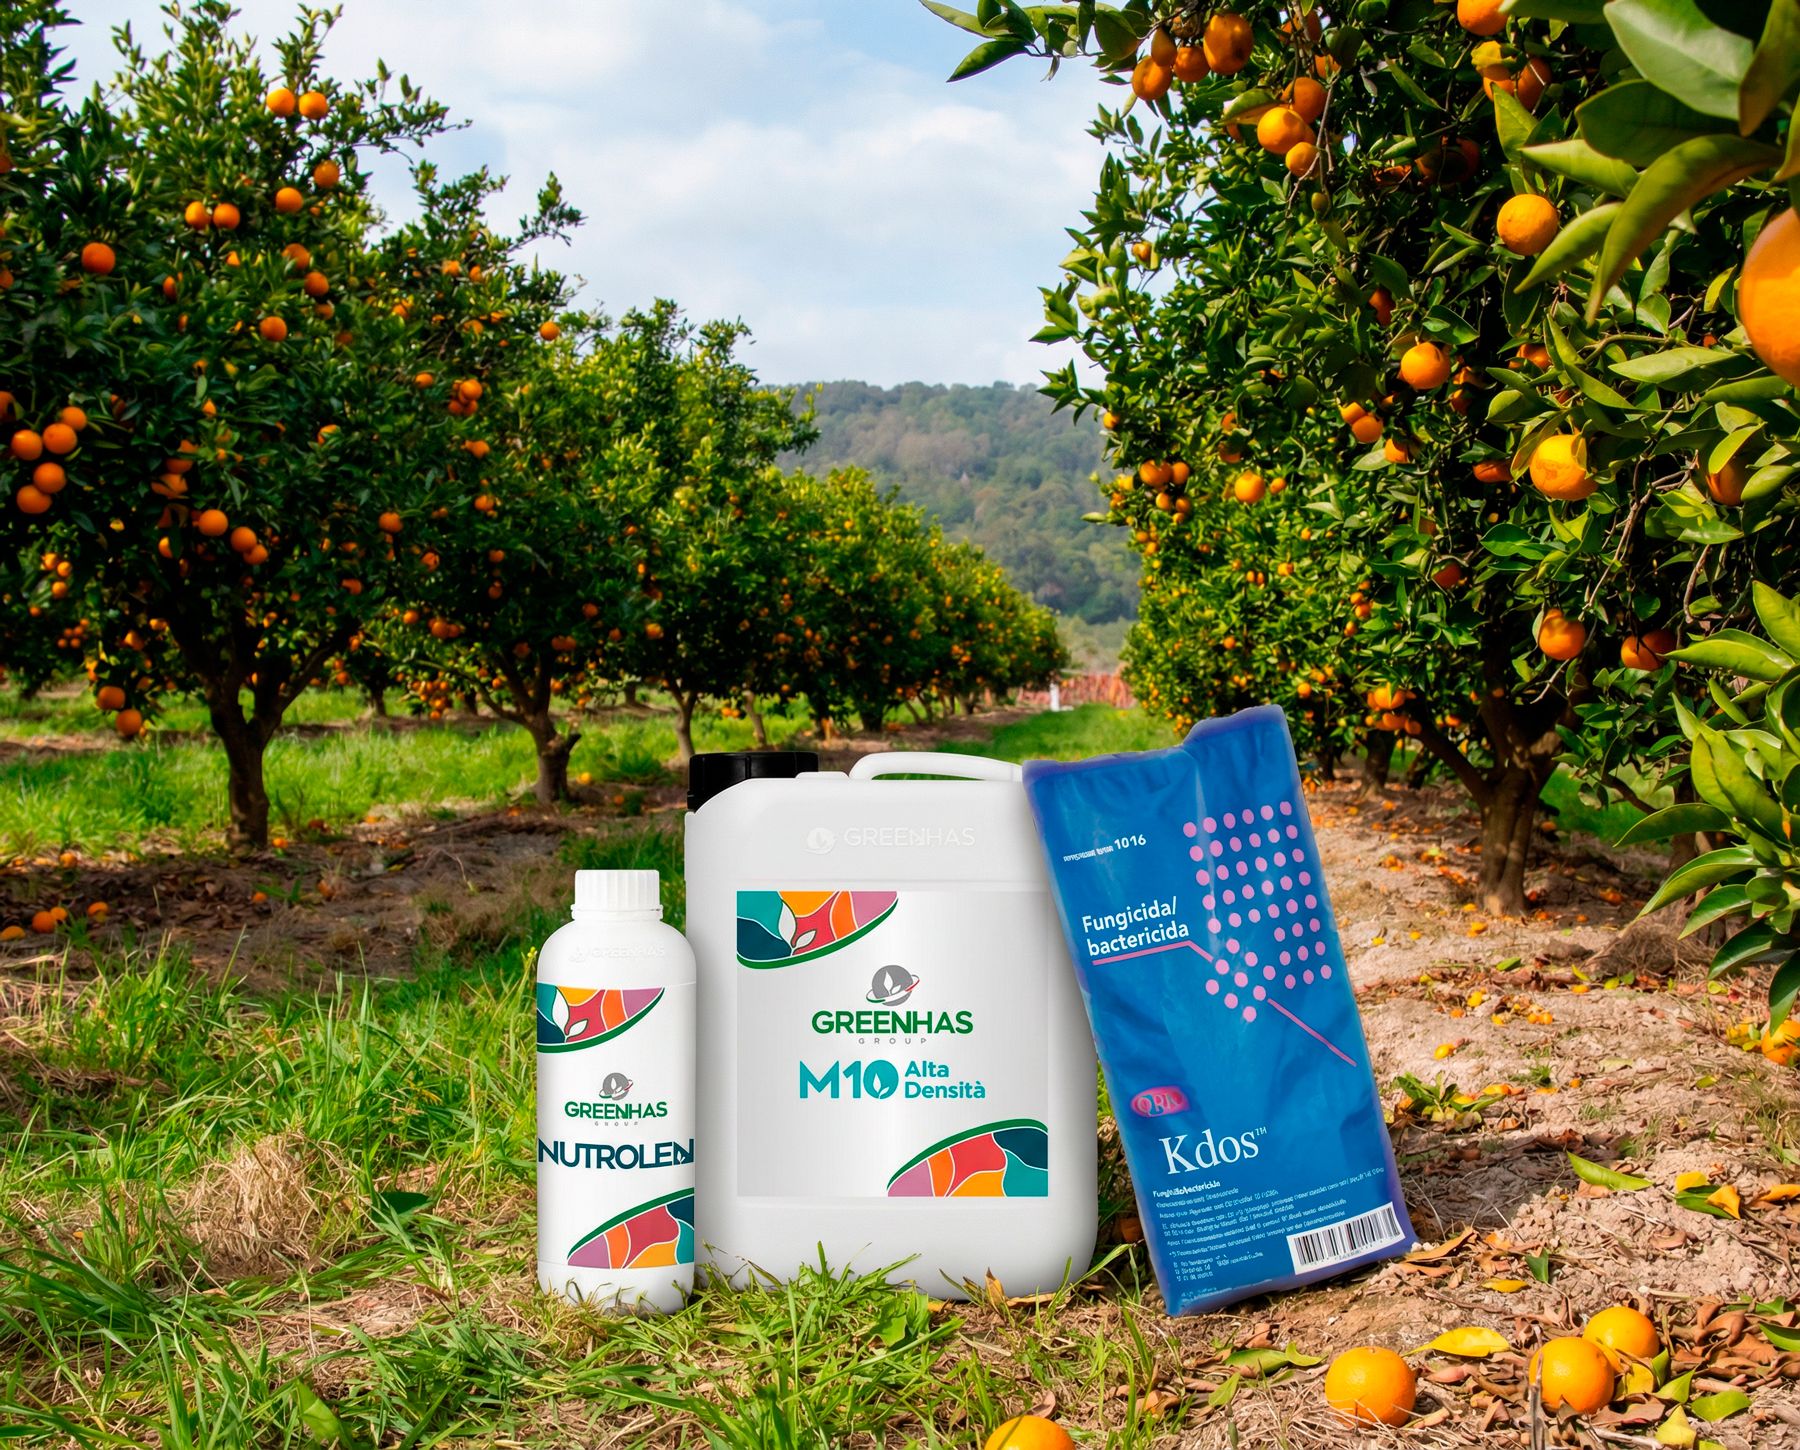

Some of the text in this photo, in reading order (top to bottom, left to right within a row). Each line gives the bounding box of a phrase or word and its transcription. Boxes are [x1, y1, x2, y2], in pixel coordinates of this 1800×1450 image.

[845, 828, 975, 846] GREENHAS
[1115, 834, 1147, 850] 1016
[1082, 896, 1177, 933] Fungicida/
[1087, 921, 1190, 956] bactericida
[811, 1010, 973, 1034] GREENHAS
[858, 1037, 927, 1045] GROUP
[799, 1060, 950, 1099] M10 Alta
[904, 1081, 986, 1099] Densità
[564, 1101, 668, 1119] GREENHAS
[538, 1138, 695, 1170] NUTROLEN
